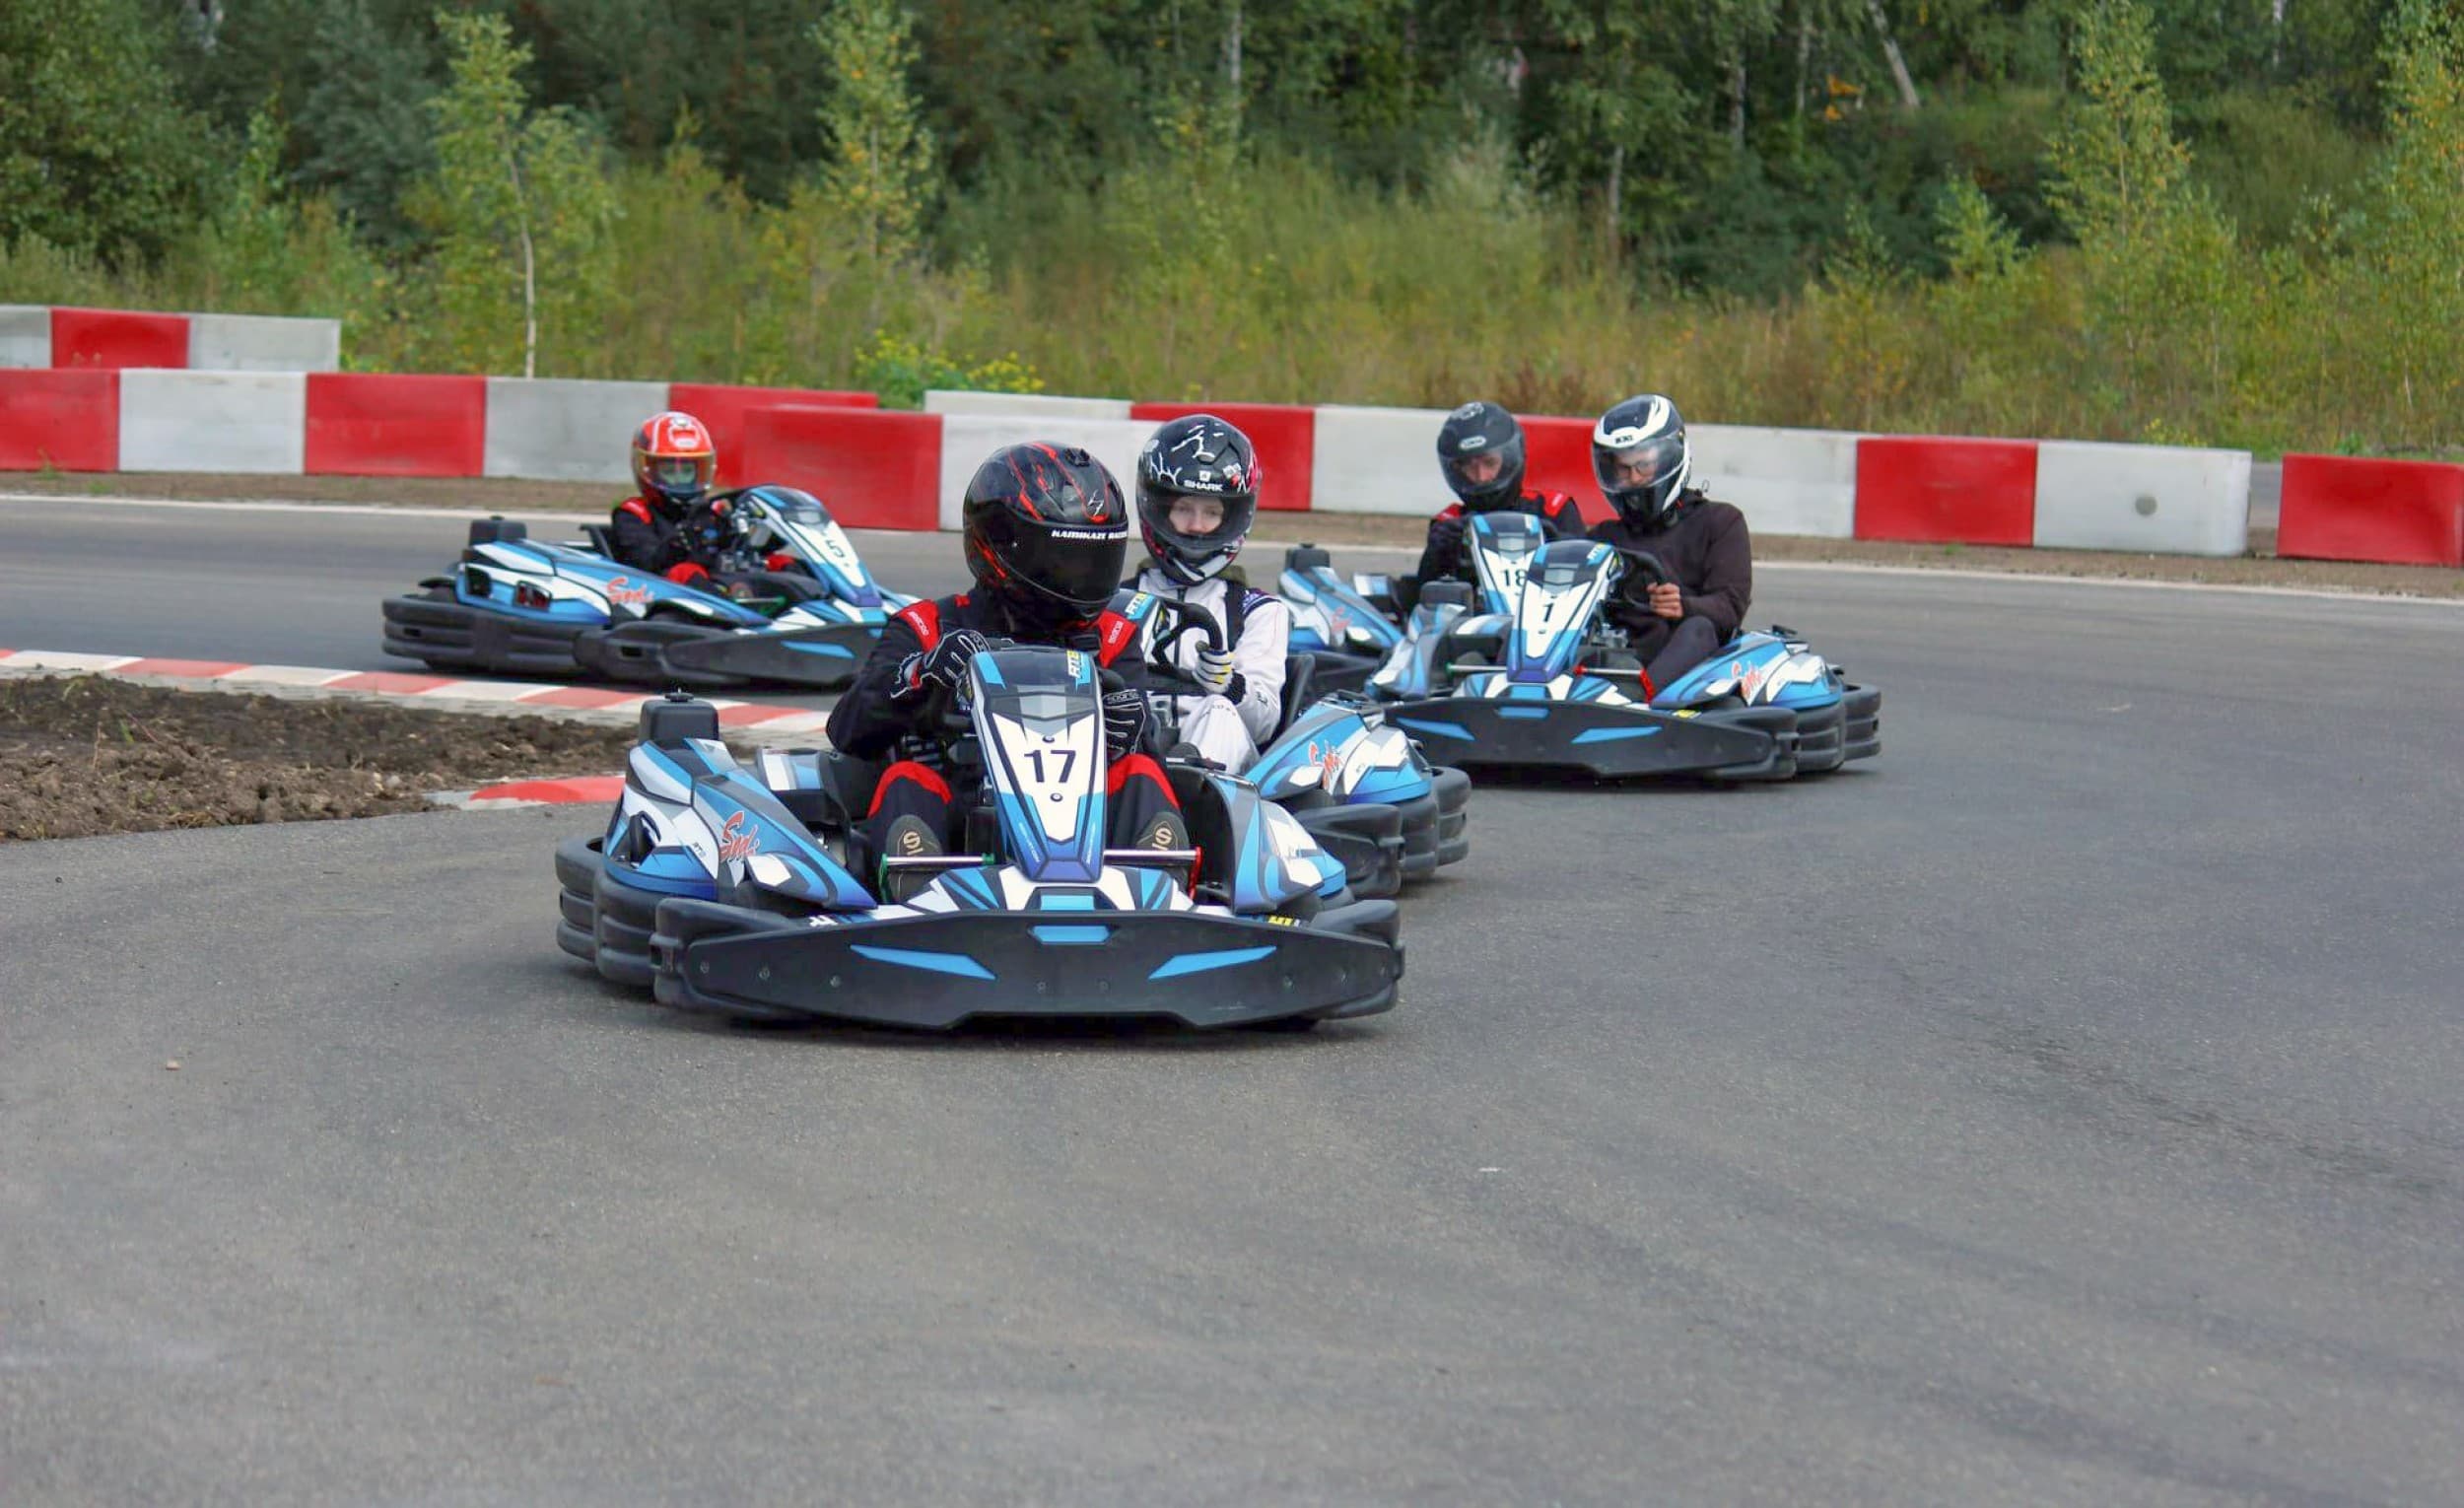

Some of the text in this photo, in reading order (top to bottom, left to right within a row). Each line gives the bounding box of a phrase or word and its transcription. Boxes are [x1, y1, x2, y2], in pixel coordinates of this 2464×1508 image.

[1184, 479, 1223, 492] SHARK
[825, 539, 845, 557] 5
[1503, 569, 1527, 587] 18
[1542, 602, 1554, 623] 1
[1024, 749, 1077, 784] 17
